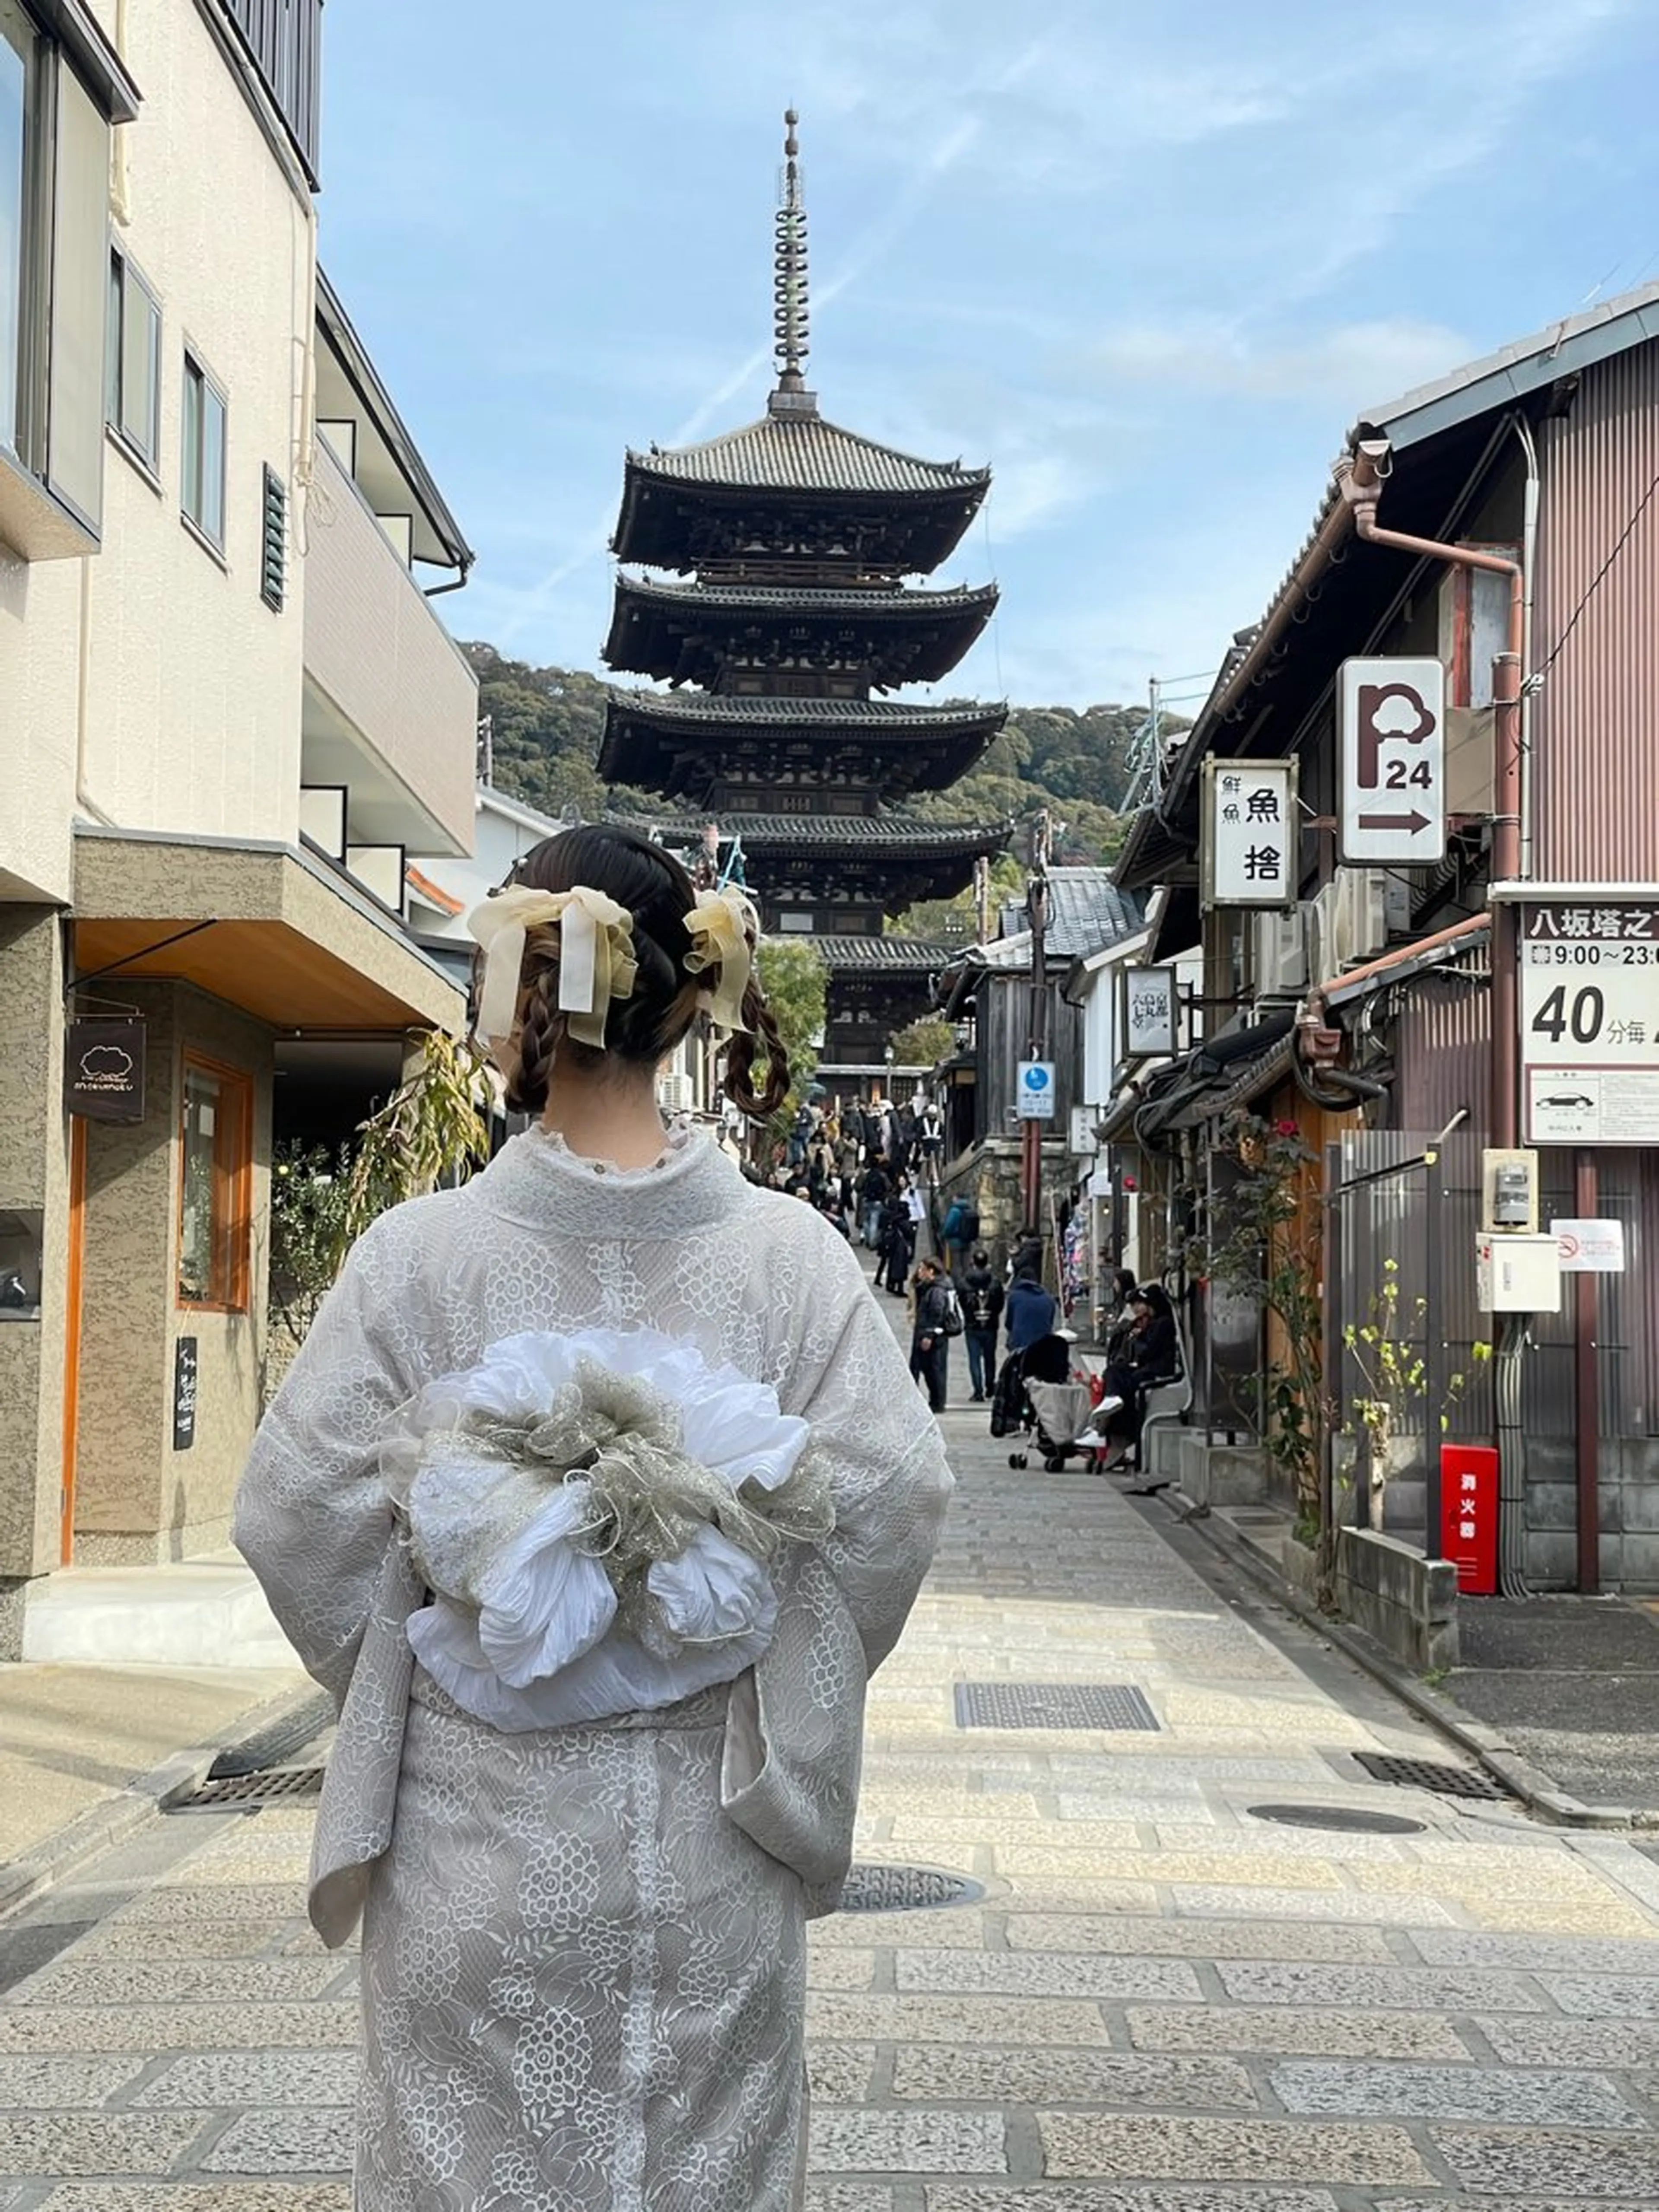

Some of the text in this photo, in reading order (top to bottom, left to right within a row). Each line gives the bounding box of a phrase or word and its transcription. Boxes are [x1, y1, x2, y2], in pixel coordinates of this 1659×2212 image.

[1386, 760, 1432, 789] 24
[1244, 788, 1281, 880] 魚捨
[1530, 909, 1659, 937] 八坂塔之
